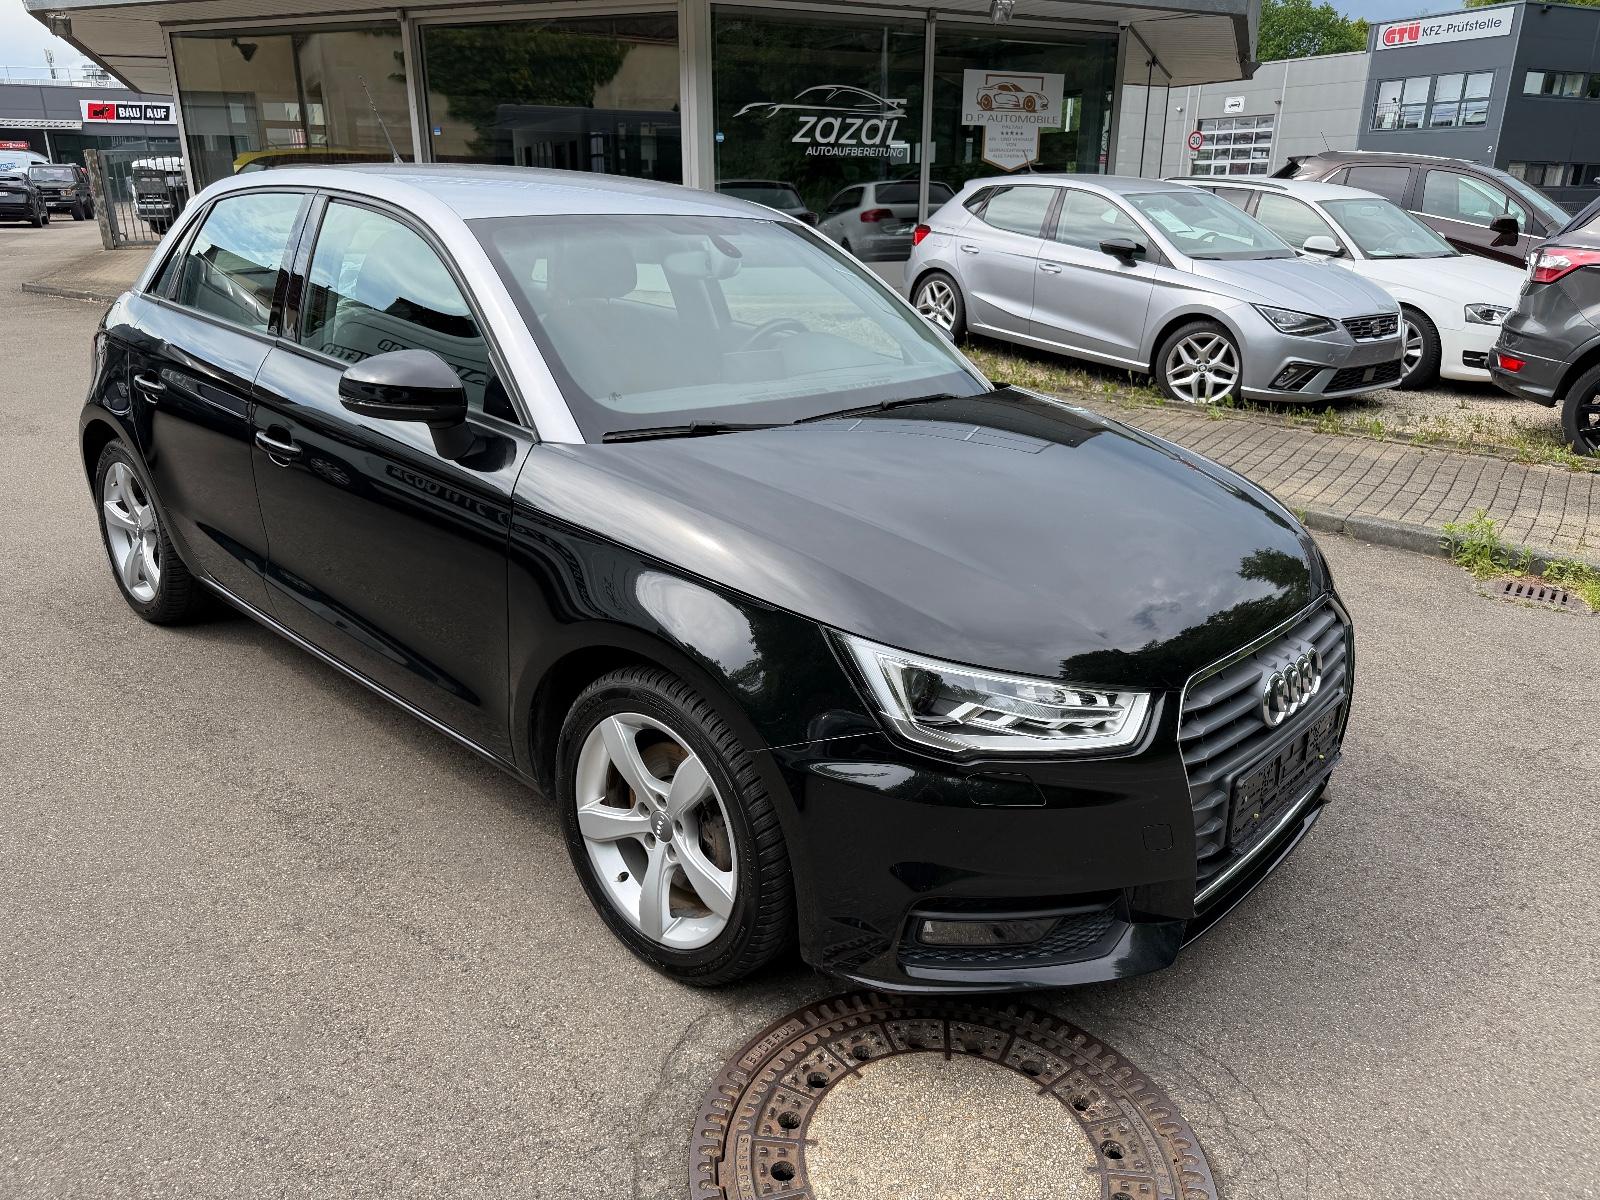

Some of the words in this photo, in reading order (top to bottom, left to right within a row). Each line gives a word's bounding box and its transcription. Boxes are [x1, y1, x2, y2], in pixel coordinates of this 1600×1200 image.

[1384, 21, 1420, 44] GTÜ
[1421, 18, 1502, 37] KFZ-Prüfstelle
[118, 107, 141, 118] BAU
[146, 108, 167, 119] AUF
[987, 114, 1059, 125] AUTOMOBILE
[1190, 136, 1201, 146] 30
[805, 146, 904, 157] AUTOAUFBEREITUNG
[1487, 145, 1493, 153] 2
[746, 1024, 797, 1065] BUDERUS
